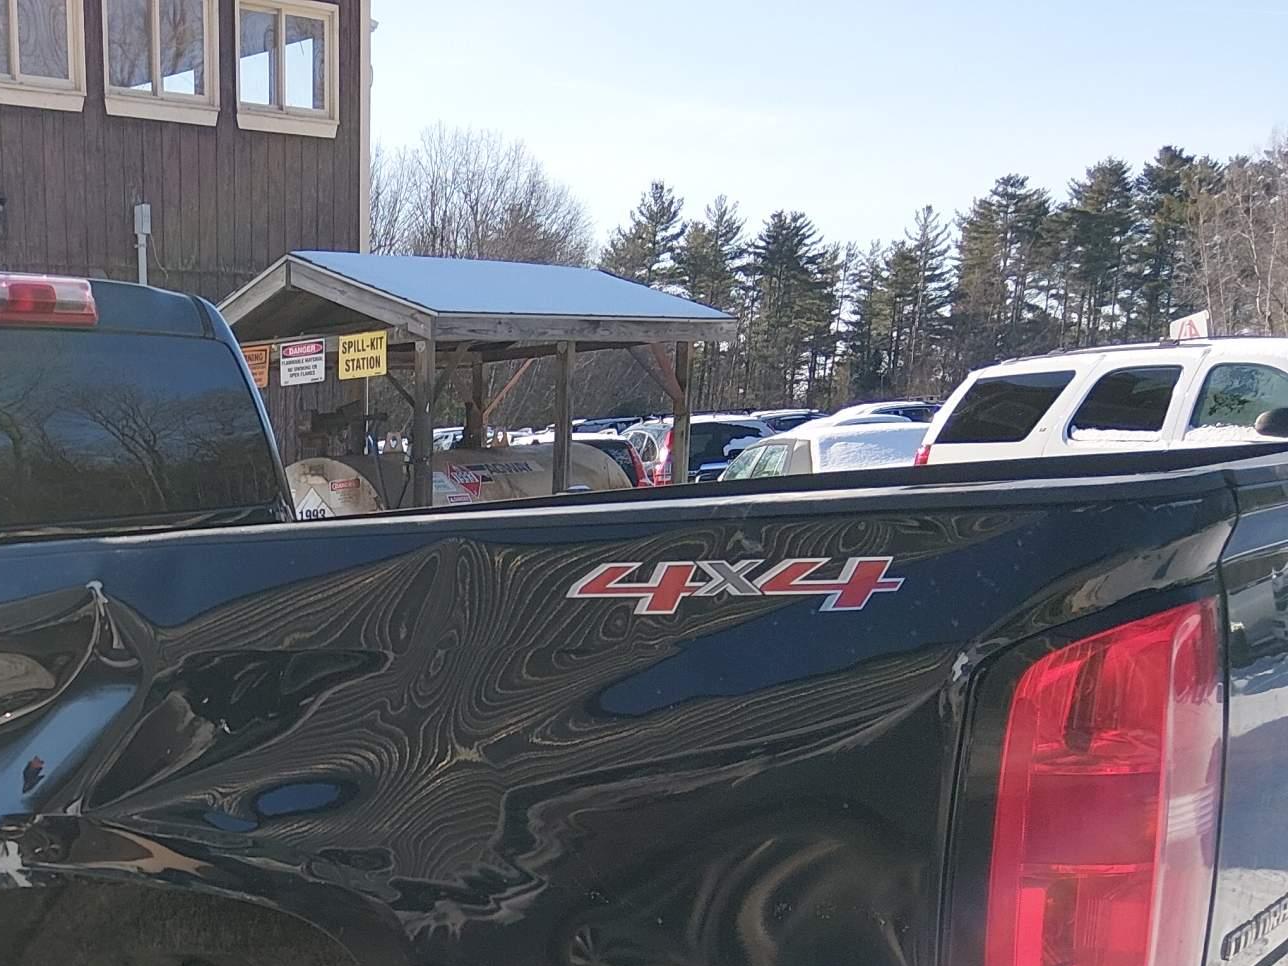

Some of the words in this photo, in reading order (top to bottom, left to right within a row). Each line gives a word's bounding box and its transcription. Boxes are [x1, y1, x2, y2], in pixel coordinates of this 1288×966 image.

[289, 344, 316, 355] DANGER
[341, 336, 384, 354] SPILL-KIT
[345, 355, 381, 372] STATION
